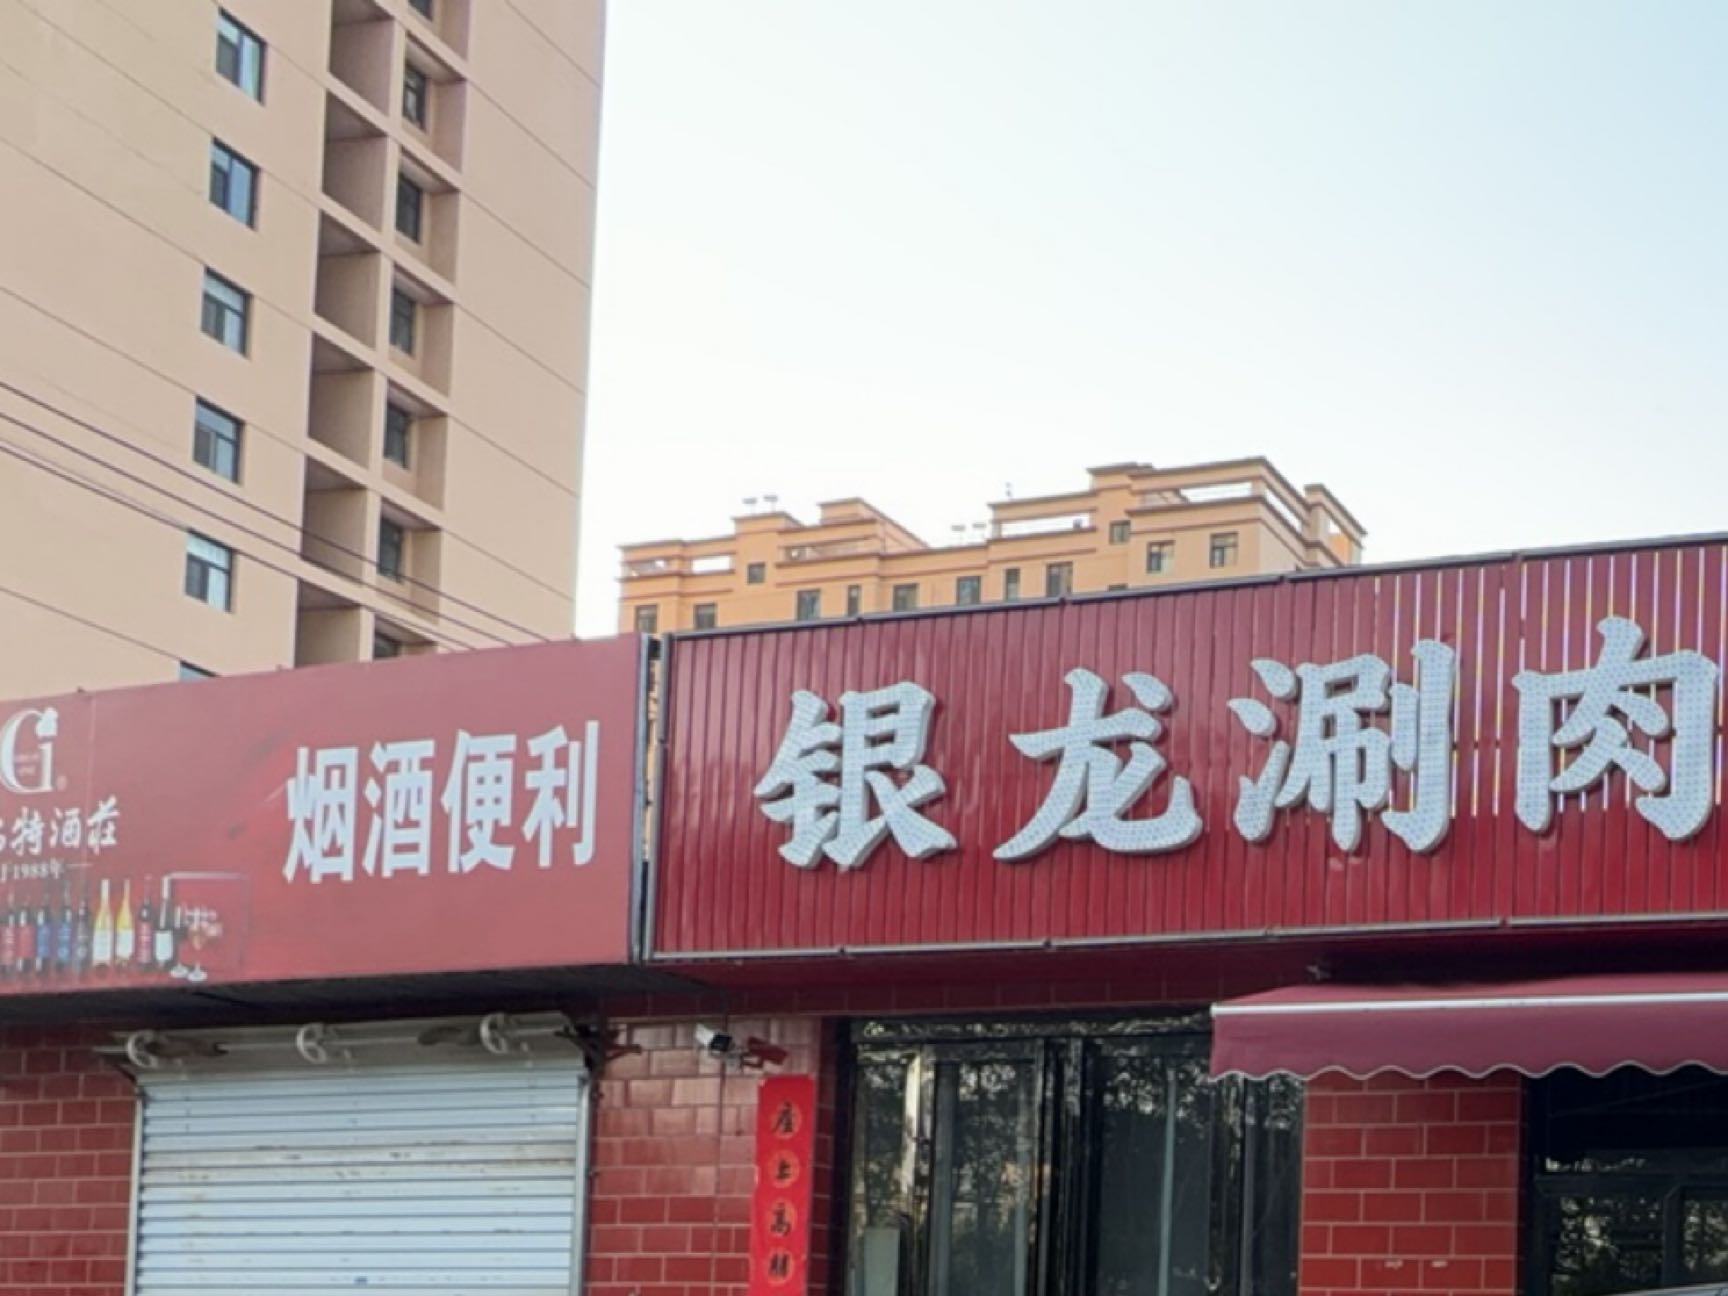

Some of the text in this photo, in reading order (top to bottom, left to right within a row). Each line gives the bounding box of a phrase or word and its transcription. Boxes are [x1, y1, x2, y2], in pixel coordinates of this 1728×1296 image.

[282, 720, 600, 884] 烟酒便利
[752, 614, 1722, 871] 银龙涮肉
